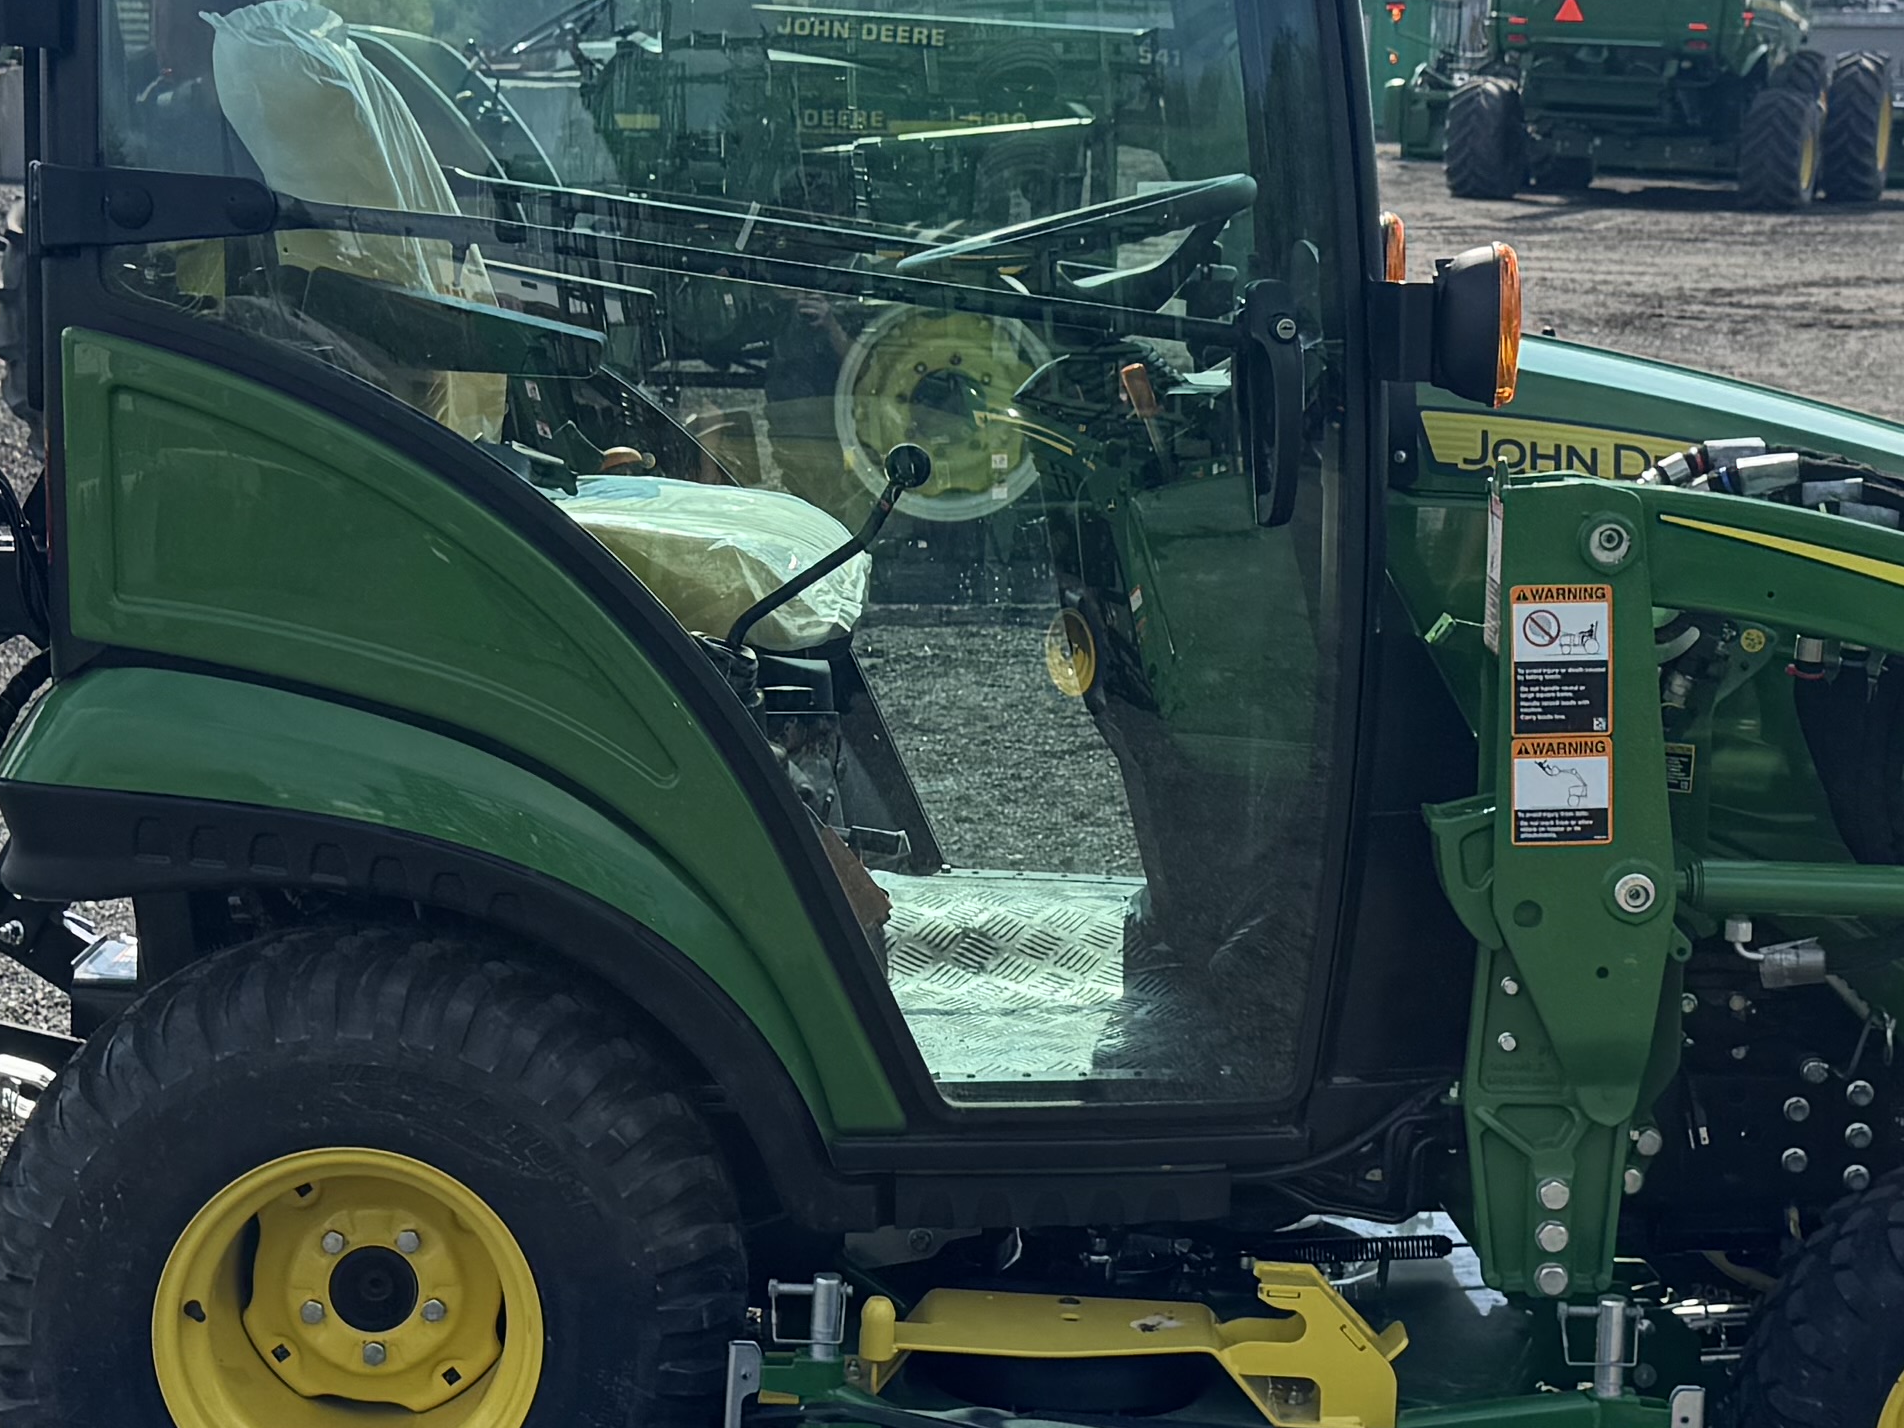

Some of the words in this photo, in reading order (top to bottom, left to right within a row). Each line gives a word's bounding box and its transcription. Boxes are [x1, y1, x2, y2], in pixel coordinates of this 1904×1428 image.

[776, 16, 850, 39] JOHN
[861, 22, 947, 47] DEERE
[1462, 429, 1598, 482] JOHN
[1530, 586, 1607, 601] WARNING
[1531, 740, 1606, 756] WARNING
